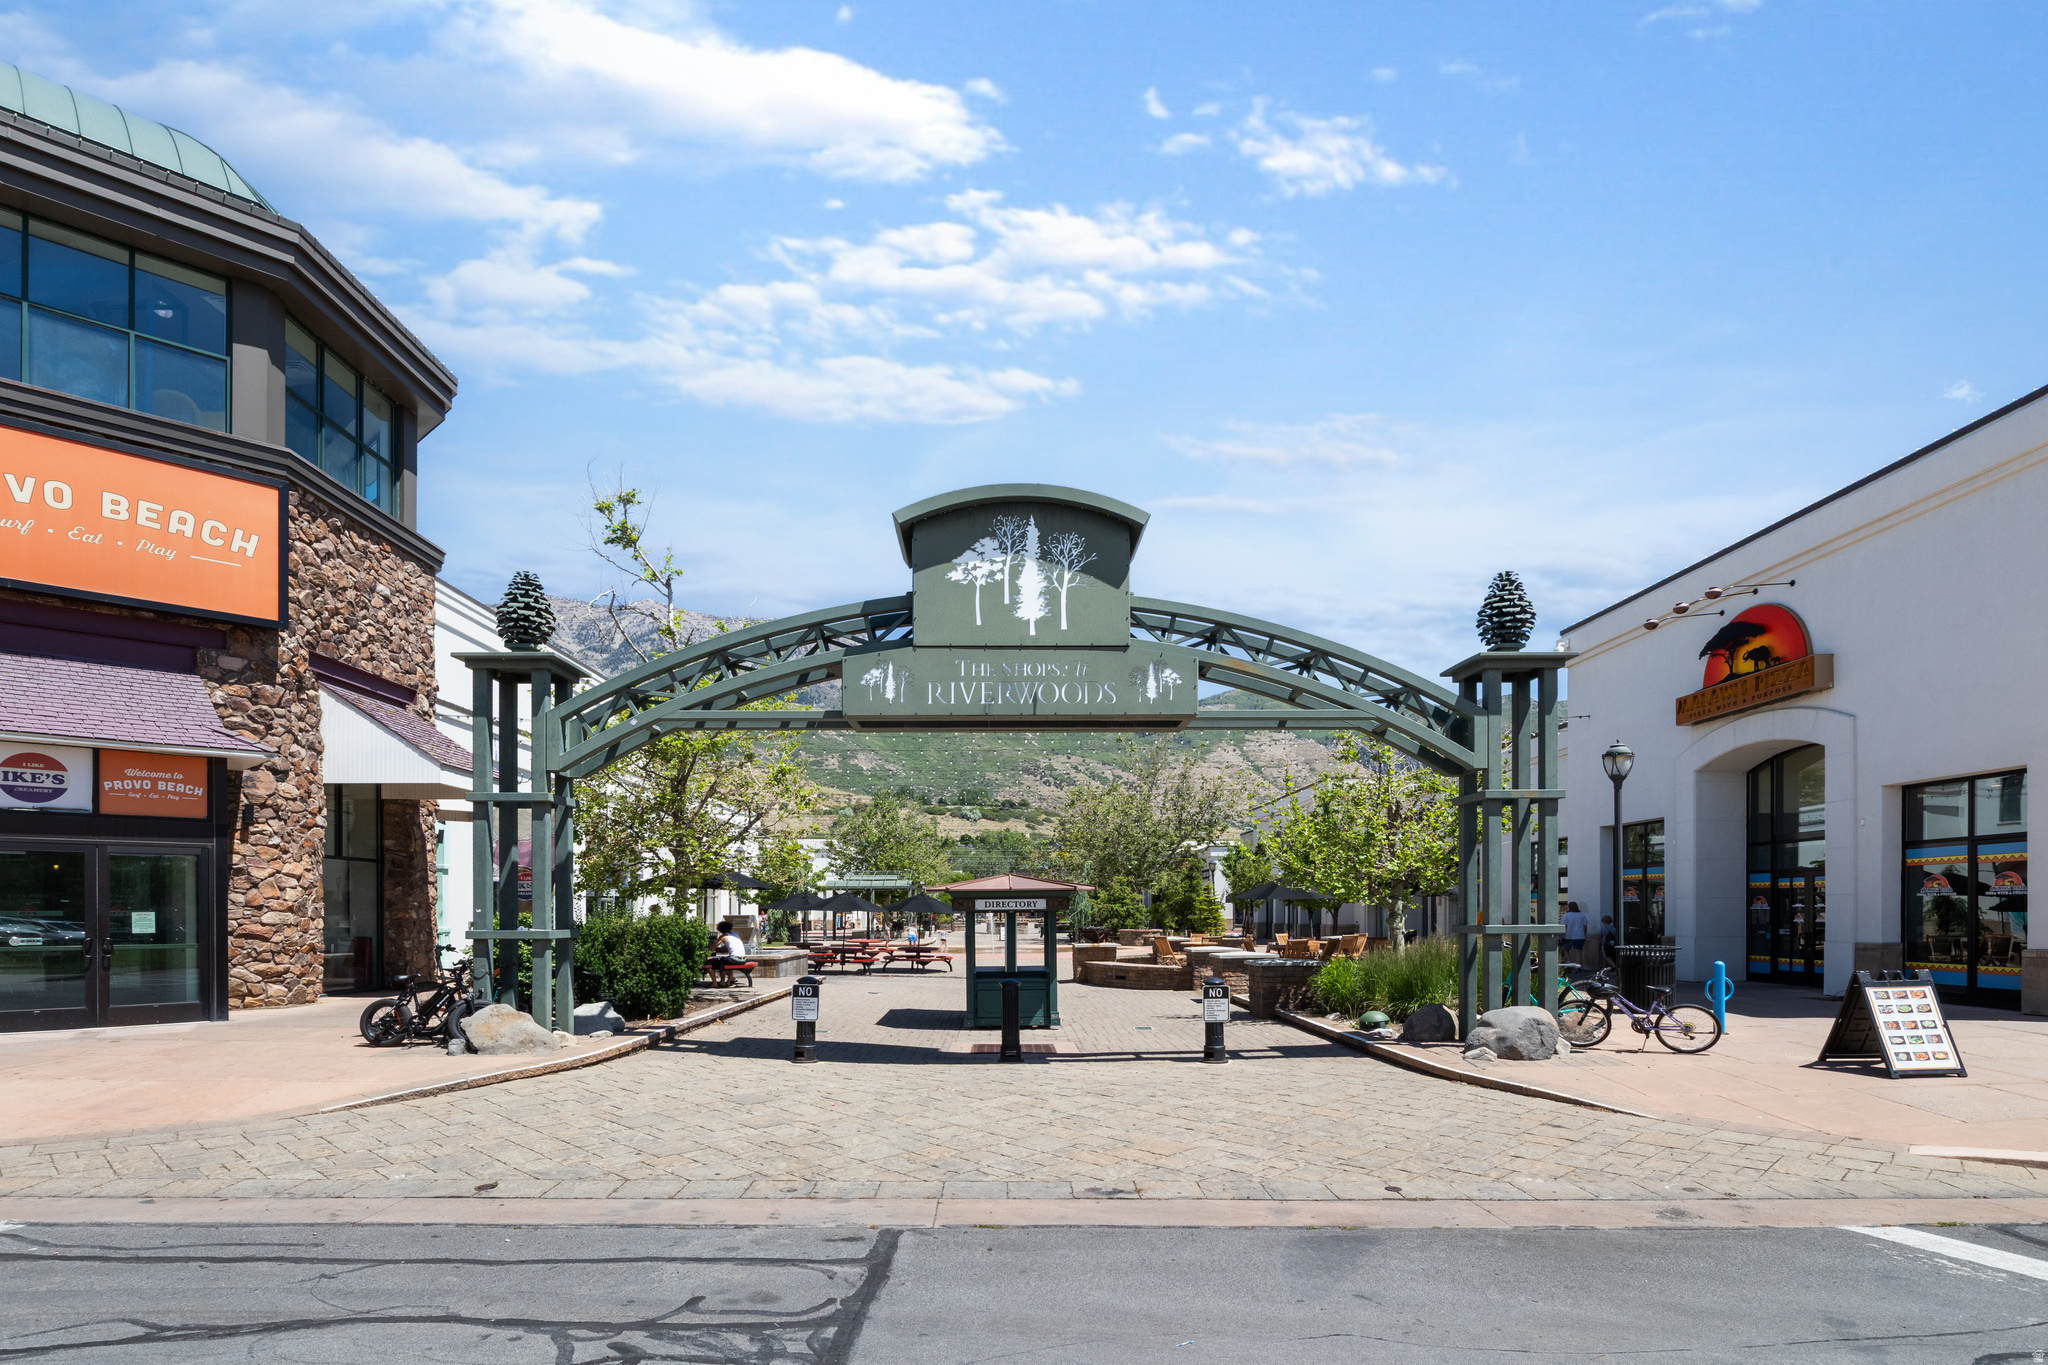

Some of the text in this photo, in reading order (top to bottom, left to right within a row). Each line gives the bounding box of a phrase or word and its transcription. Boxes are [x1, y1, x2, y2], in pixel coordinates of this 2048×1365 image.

[101, 490, 260, 558] BEACH
[0, 518, 177, 561] urf Eat Play
[955, 659, 997, 677] THE
[1002, 659, 1061, 677] SHOPS
[1754, 660, 1811, 692] PIZZA
[927, 681, 1117, 705] RIVERWOODS
[1689, 709, 1712, 719] PIZZA
[1716, 701, 1738, 712] WITH
[1751, 684, 1793, 701] PURPOSE
[1, 770, 66, 785] IKE'S
[124, 768, 184, 780] Welcome to
[103, 779, 203, 797] PROVO BEACH
[128, 791, 141, 799] Surf
[167, 793, 180, 801] Play
[984, 900, 1038, 908] DIRECTORY
[798, 986, 813, 997] NO
[1209, 988, 1223, 998] NO
